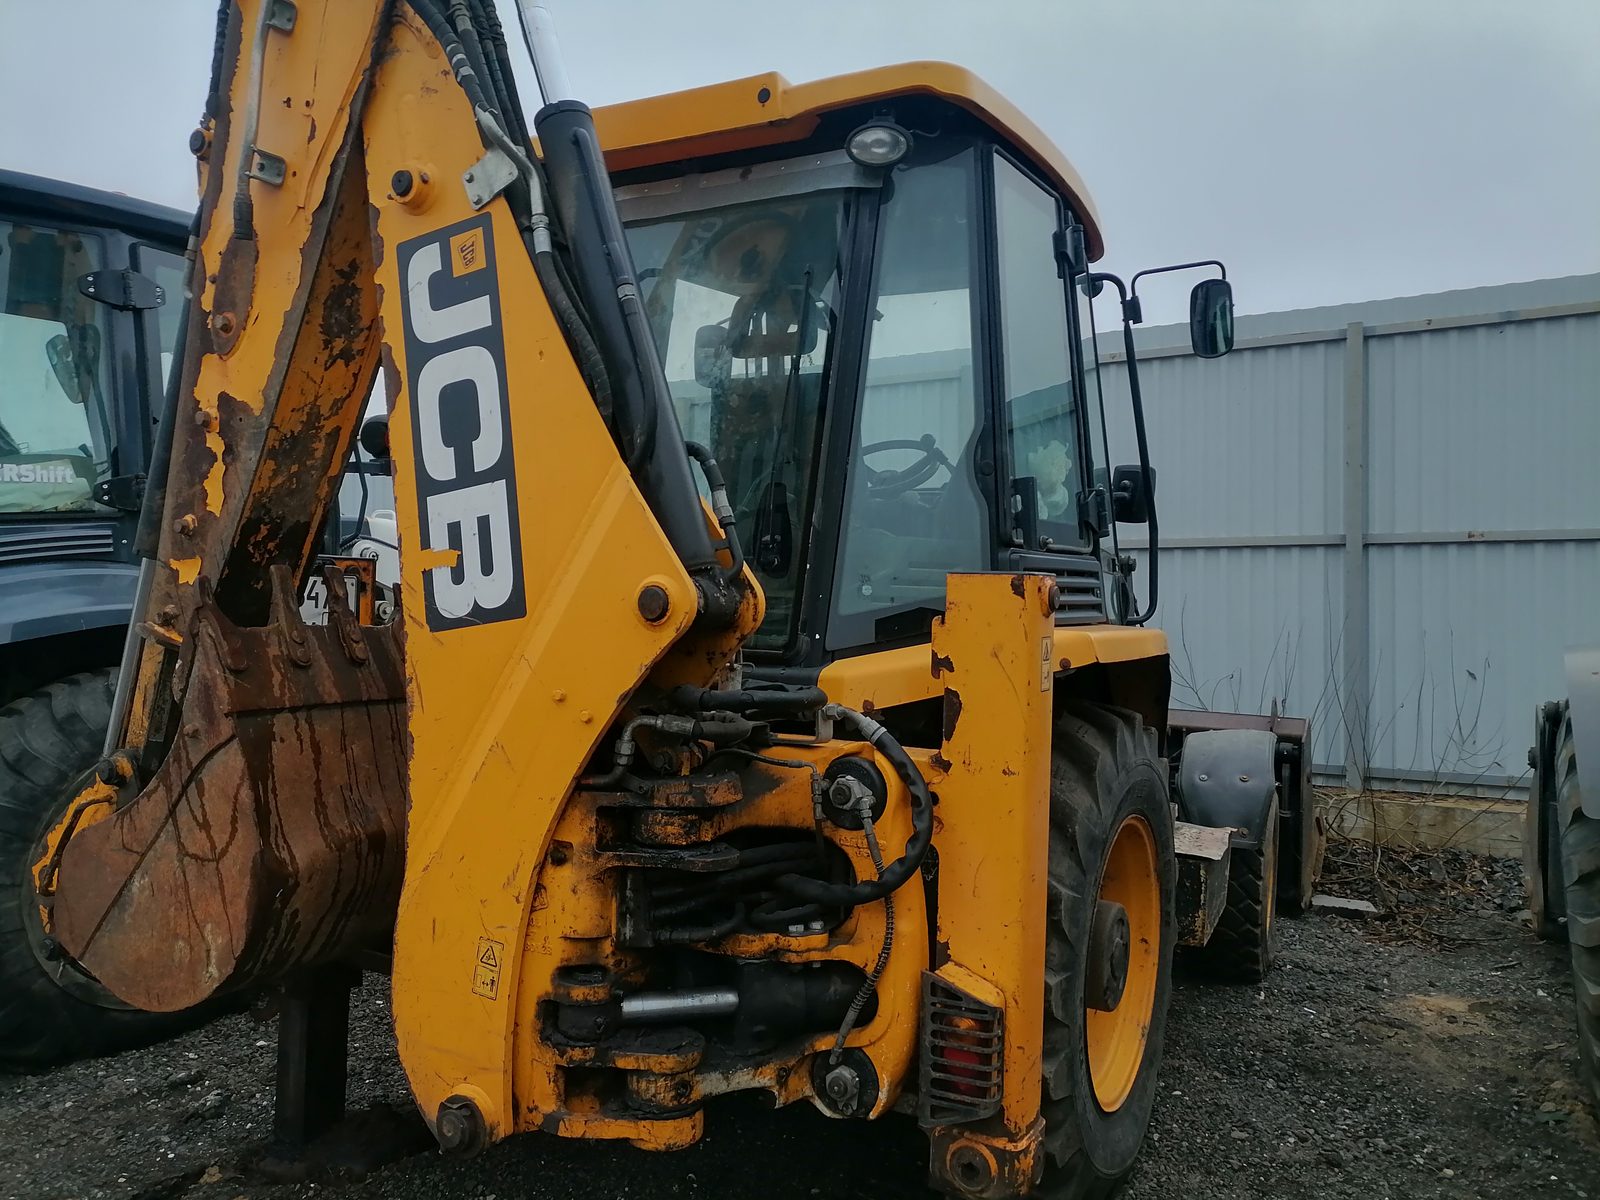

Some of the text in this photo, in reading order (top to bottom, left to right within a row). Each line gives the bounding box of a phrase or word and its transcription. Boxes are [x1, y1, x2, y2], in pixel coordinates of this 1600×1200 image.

[459, 240, 476, 267] JCB
[407, 241, 514, 619] JCB
[0, 463, 73, 484] RShift
